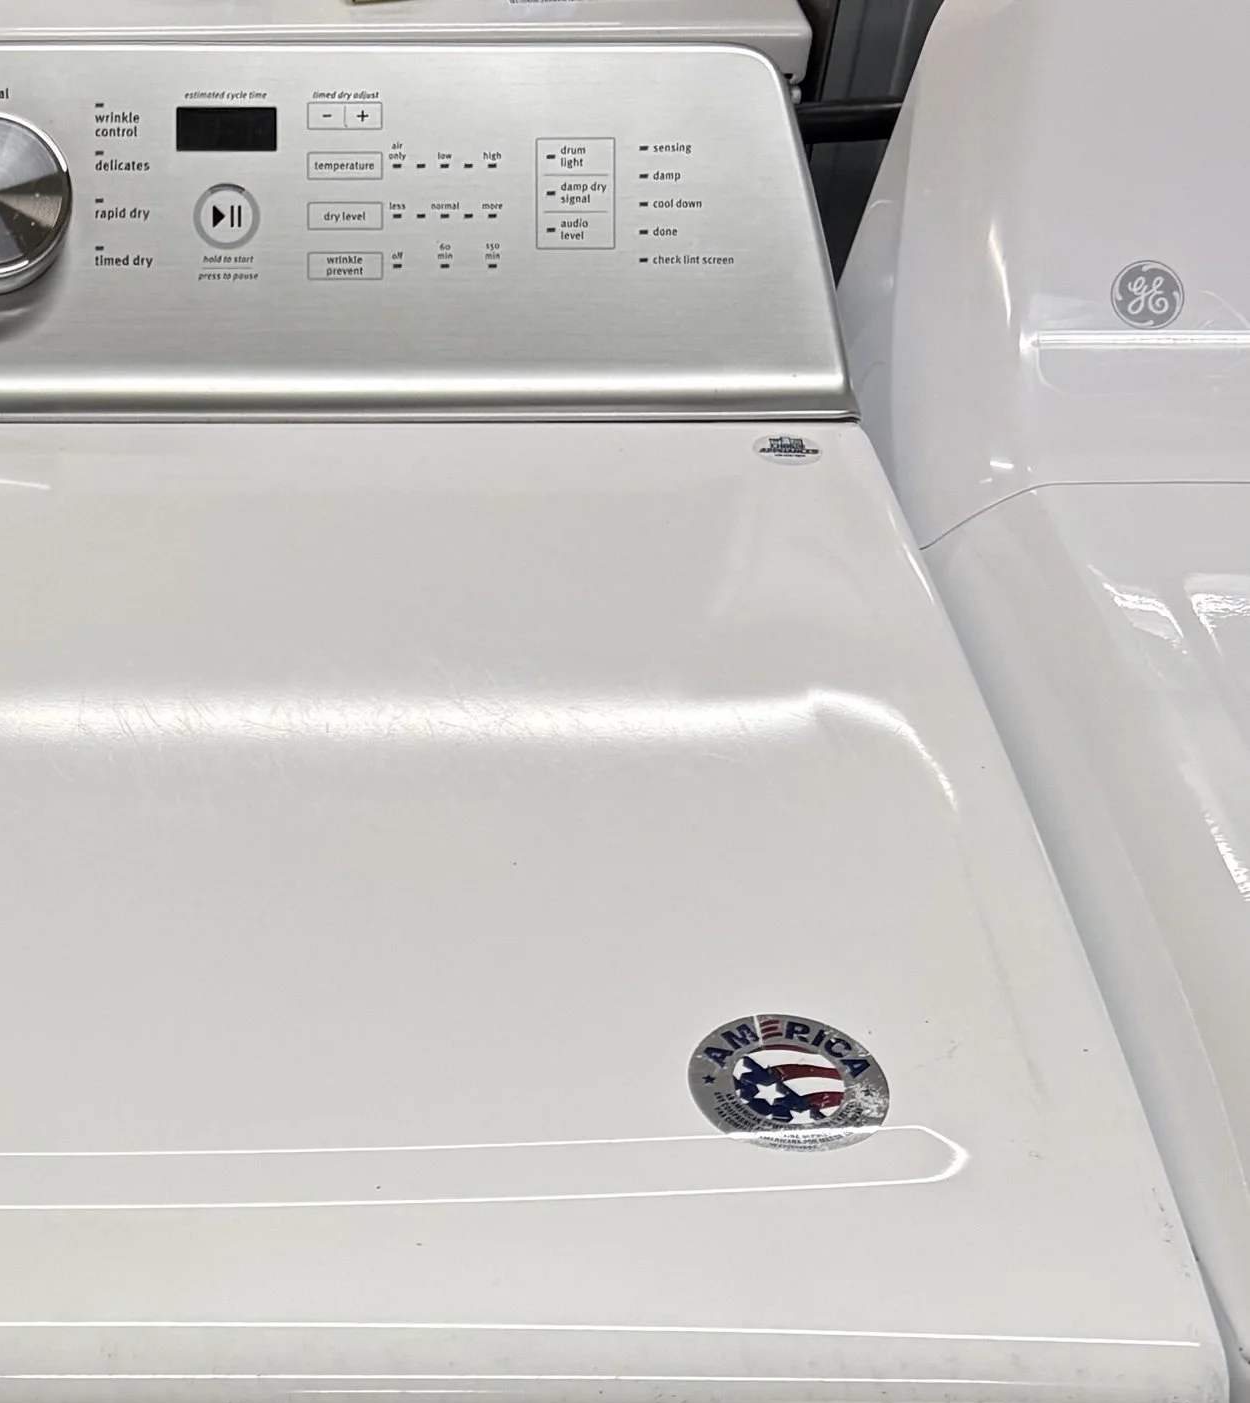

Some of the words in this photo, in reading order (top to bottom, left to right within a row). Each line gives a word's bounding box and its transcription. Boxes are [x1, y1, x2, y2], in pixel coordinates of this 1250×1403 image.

[185, 91, 224, 100] estimated
[227, 91, 247, 101] cycle
[249, 91, 267, 99] time
[313, 91, 336, 99] timed
[338, 91, 352, 100] dry
[353, 91, 379, 100] adjust
[95, 112, 139, 125] wrinkle
[95, 126, 137, 137] control
[561, 146, 585, 154] drum
[654, 143, 691, 154] sensing
[389, 153, 406, 161] only
[483, 152, 501, 161] high
[95, 160, 149, 171] delicates
[315, 162, 374, 171] temperature
[561, 158, 583, 168] light
[653, 171, 680, 182] damp
[561, 182, 588, 193] damp
[590, 182, 607, 194] dry
[561, 194, 590, 205] signal
[653, 199, 674, 208] cool
[676, 199, 702, 208] down
[390, 202, 406, 210] less
[431, 202, 459, 210] normal
[95, 207, 126, 220] rapid
[130, 208, 149, 221] dry
[324, 212, 340, 222] dry
[343, 212, 365, 220] level
[561, 219, 588, 228] audio
[561, 231, 583, 240] level
[653, 227, 677, 236] done
[439, 243, 451, 251] 60
[203, 255, 223, 263] hold
[234, 255, 254, 263] start
[327, 254, 363, 264] wrinkle
[437, 252, 453, 260] min
[485, 252, 500, 260] min
[653, 254, 681, 264] check
[683, 255, 700, 264] lint
[701, 255, 734, 264] screen
[95, 255, 129, 266] timed
[133, 255, 153, 268] dry
[327, 267, 363, 276] prevent
[198, 273, 222, 281] press
[224, 272, 233, 280] to
[235, 273, 259, 281] pause
[704, 1019, 870, 1078] AMERICA
